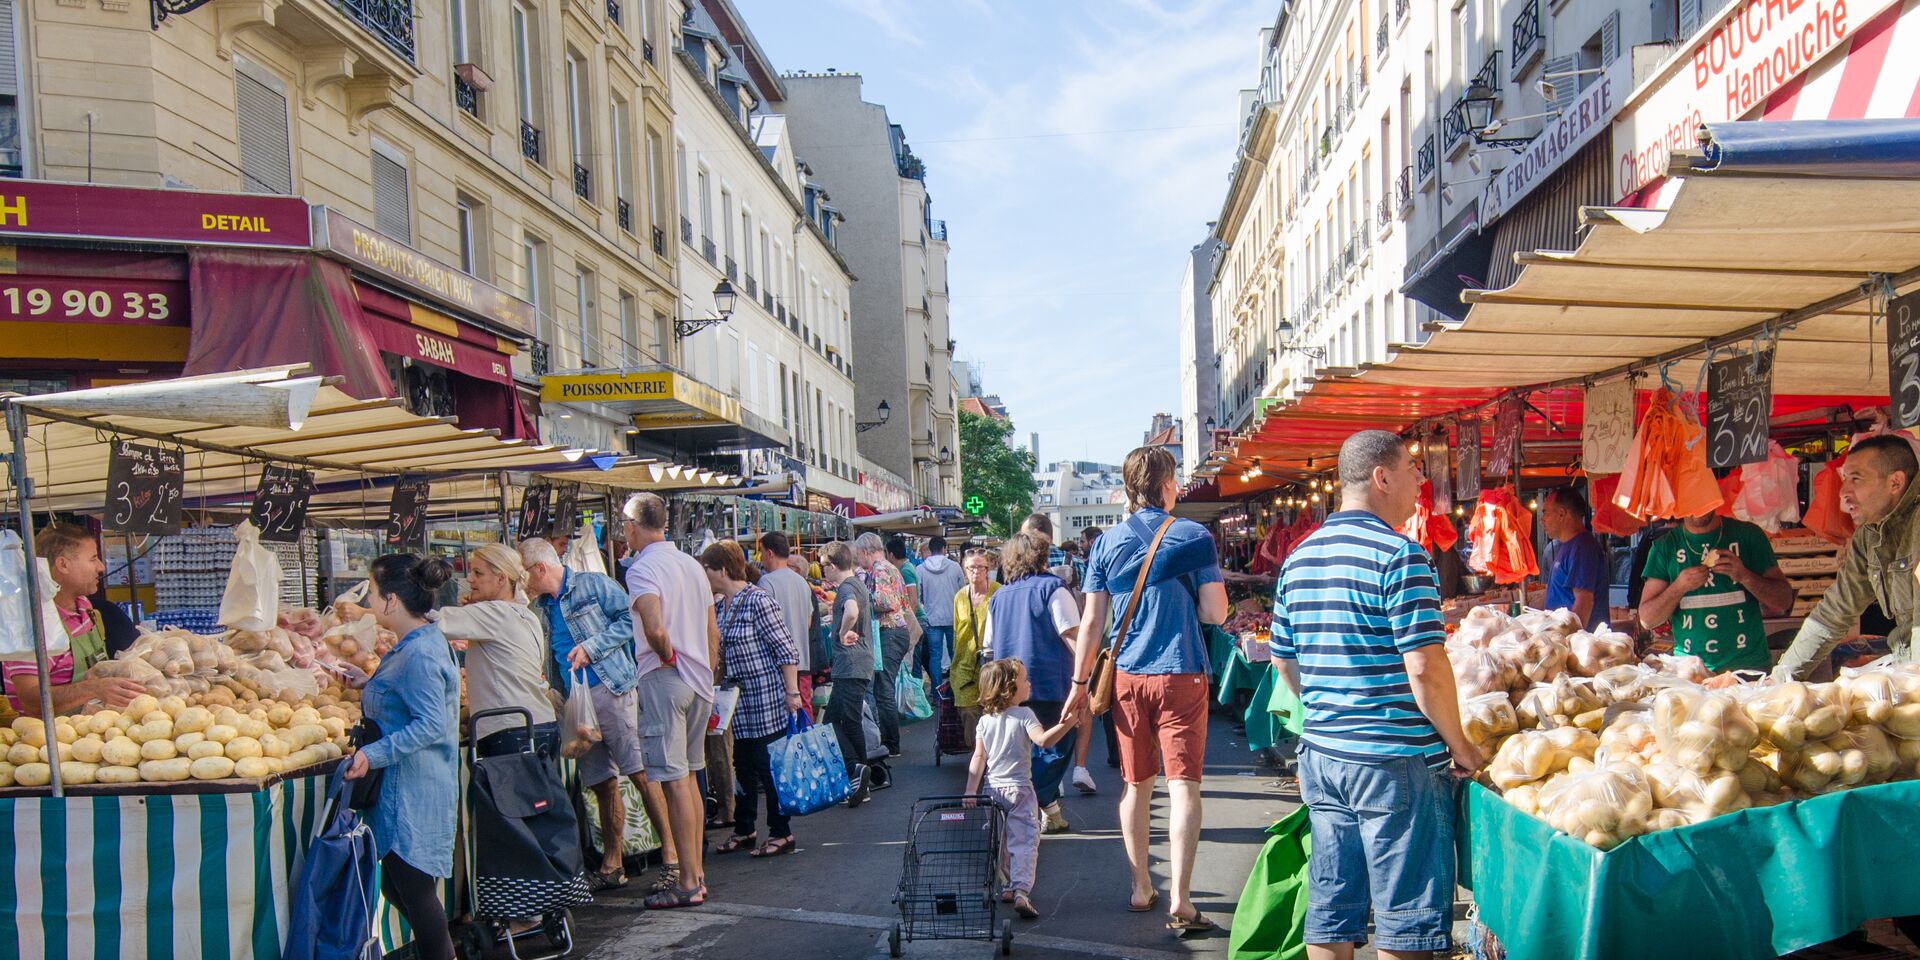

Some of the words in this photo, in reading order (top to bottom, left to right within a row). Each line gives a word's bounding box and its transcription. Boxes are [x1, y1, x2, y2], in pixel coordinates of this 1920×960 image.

[1726, 0, 1848, 121] Hamouche
[1507, 78, 1613, 200] FROMAGERIE
[1620, 103, 1702, 198] Charcuterie
[202, 213, 271, 233] DETAIL
[353, 228, 415, 278] PRODUITS
[416, 258, 474, 306] ORIENTAUX
[3, 288, 51, 316] 19
[62, 290, 112, 318] 90
[123, 292, 169, 320] 33
[415, 333, 455, 365] SABAH
[562, 381, 667, 397] POISSONNERIE
[1713, 412, 1735, 466] 3
[116, 481, 133, 524] 3
[260, 500, 273, 535] 3
[390, 512, 402, 537] 3
